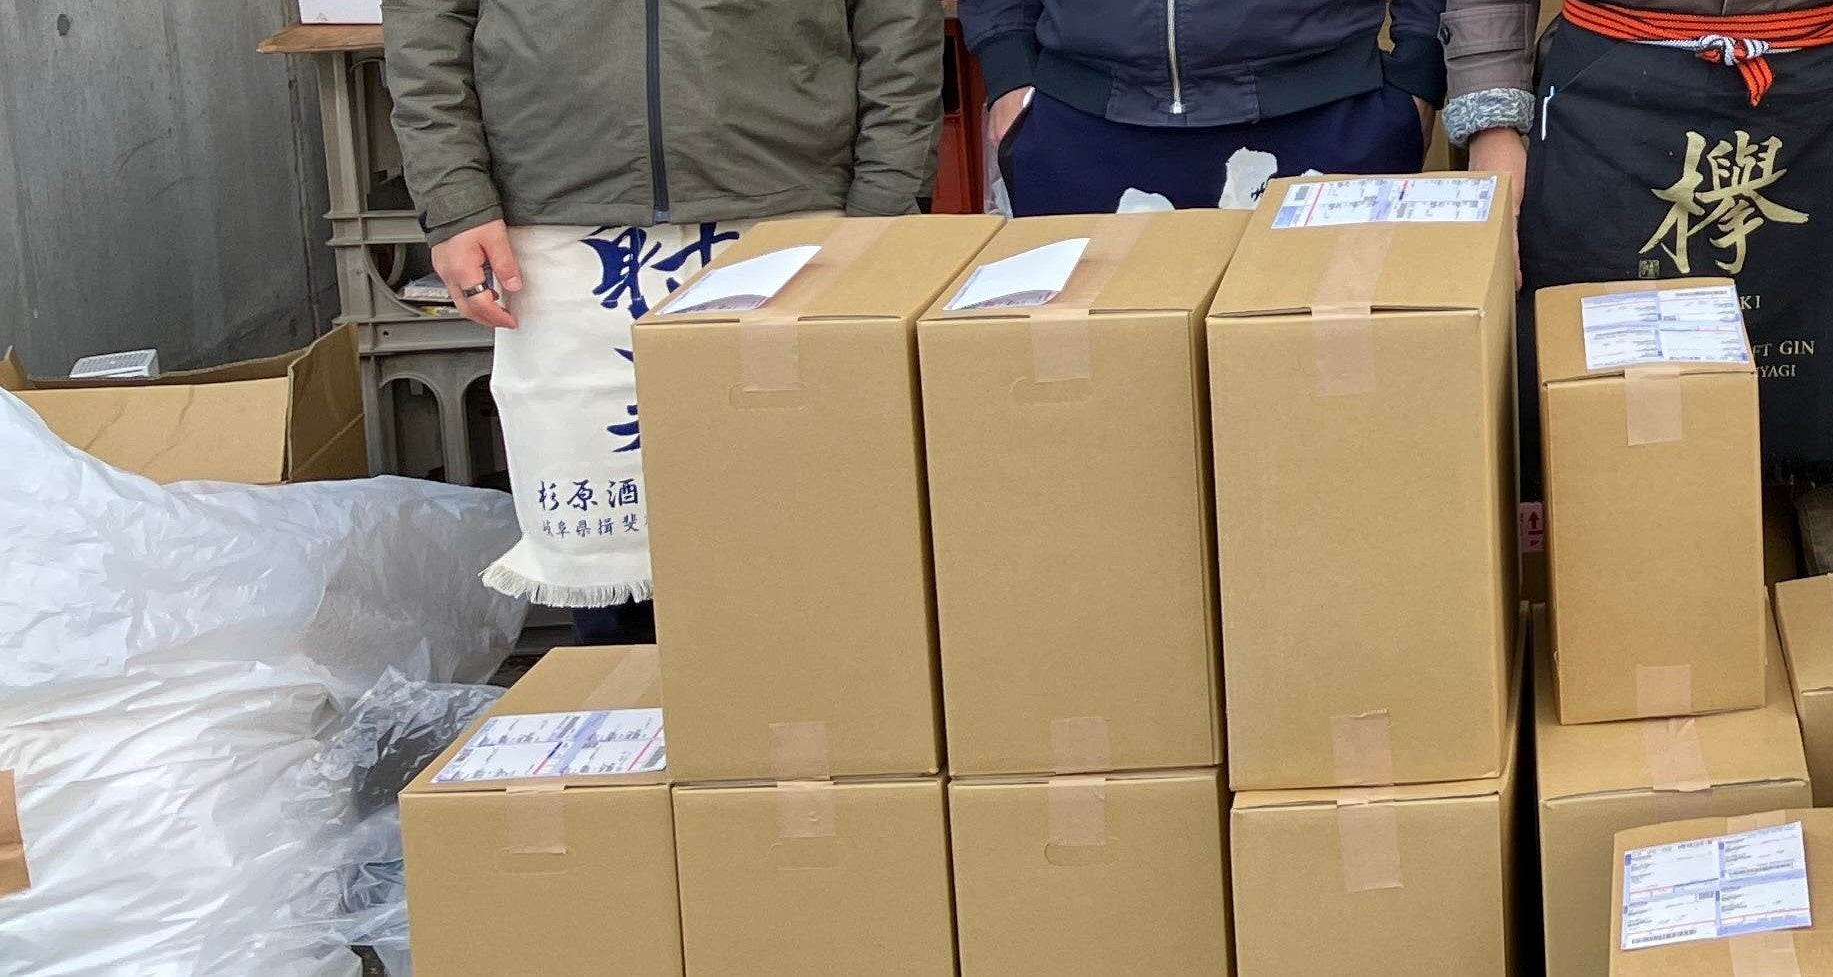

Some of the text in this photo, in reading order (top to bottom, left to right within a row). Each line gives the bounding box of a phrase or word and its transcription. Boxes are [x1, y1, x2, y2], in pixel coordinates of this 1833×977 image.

[1740, 295, 1761, 310] KI
[1779, 340, 1815, 355] GIN
[543, 513, 649, 539] 岐阜県揖斐
